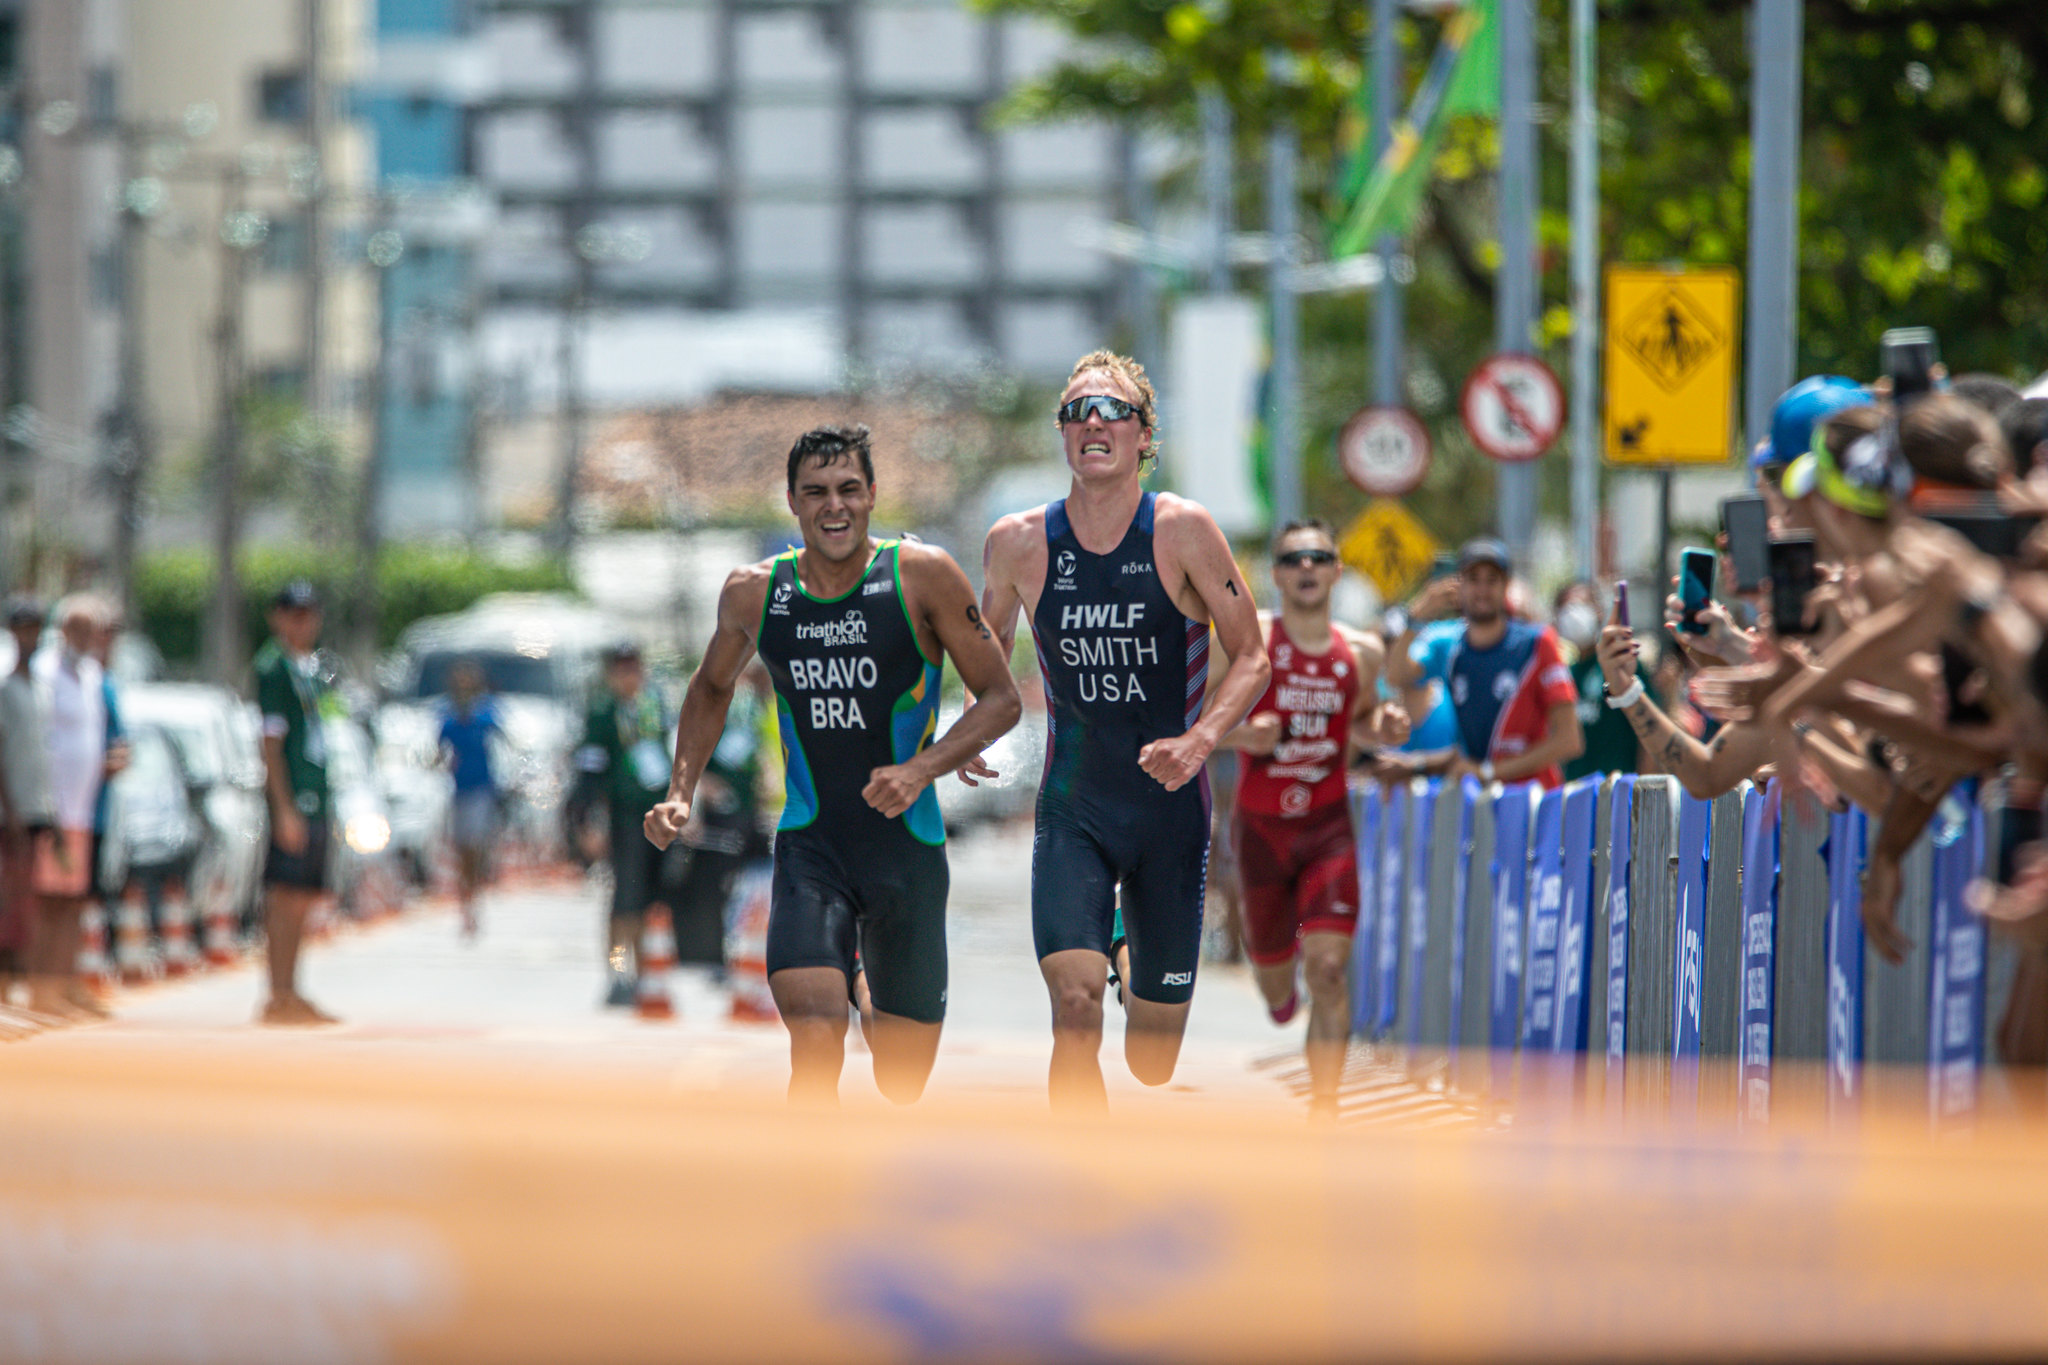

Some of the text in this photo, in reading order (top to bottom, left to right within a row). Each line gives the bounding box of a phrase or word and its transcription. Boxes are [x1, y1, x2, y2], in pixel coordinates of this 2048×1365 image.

[1225, 579, 1239, 597] 1
[796, 619, 867, 640] triathlon
[1060, 603, 1146, 630] HWLF
[823, 633, 868, 647] BRASIL
[1059, 636, 1159, 667] SMITH
[789, 656, 878, 690] BRAVO
[1078, 672, 1147, 703] USA
[810, 697, 866, 729] BRA
[1161, 971, 1192, 986] ASU
